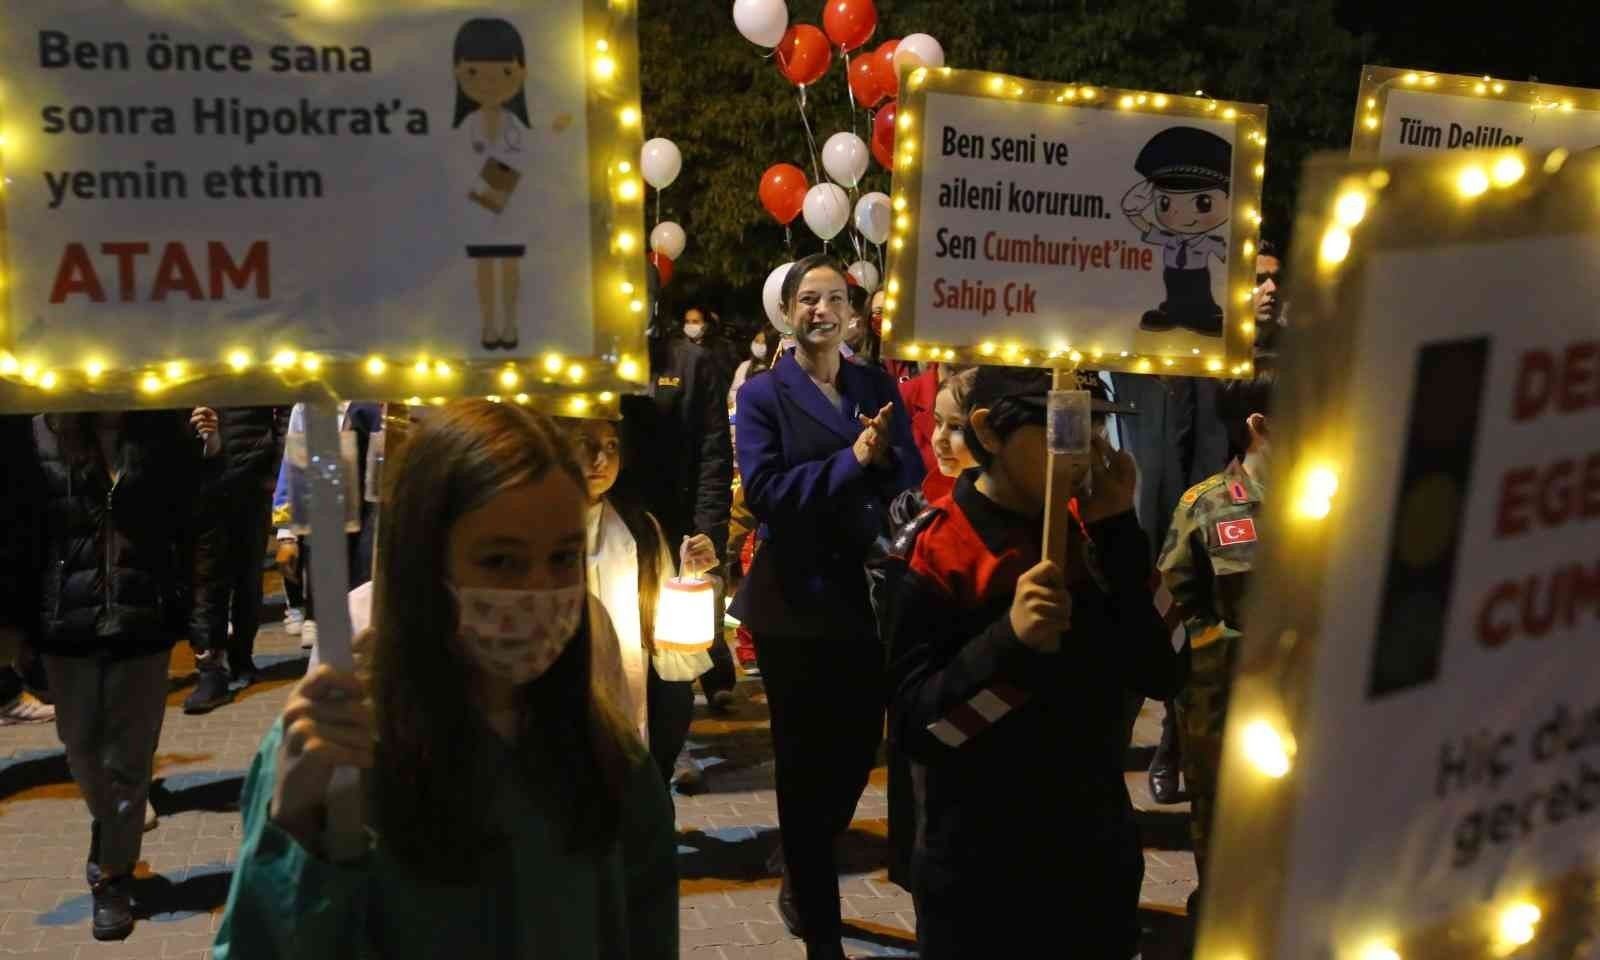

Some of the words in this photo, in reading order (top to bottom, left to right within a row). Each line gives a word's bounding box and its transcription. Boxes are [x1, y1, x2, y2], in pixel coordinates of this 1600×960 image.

[39, 30, 129, 71] Ben
[147, 32, 252, 72] önce
[269, 39, 372, 73] sana
[42, 102, 176, 137] sonra
[193, 95, 430, 145] Hipokrat'a
[1399, 117, 1441, 149] Tüm
[942, 125, 984, 159] Ben
[991, 134, 1036, 164] seni
[1043, 142, 1069, 166] ve
[44, 162, 188, 209] yemin
[203, 161, 324, 200] ettim
[938, 178, 1001, 212] aileni
[1008, 182, 1112, 220] korurum.
[935, 227, 977, 260] Sen
[49, 240, 272, 304] ATAM
[932, 277, 997, 317] Sahip
[1003, 282, 1036, 316] Çık
